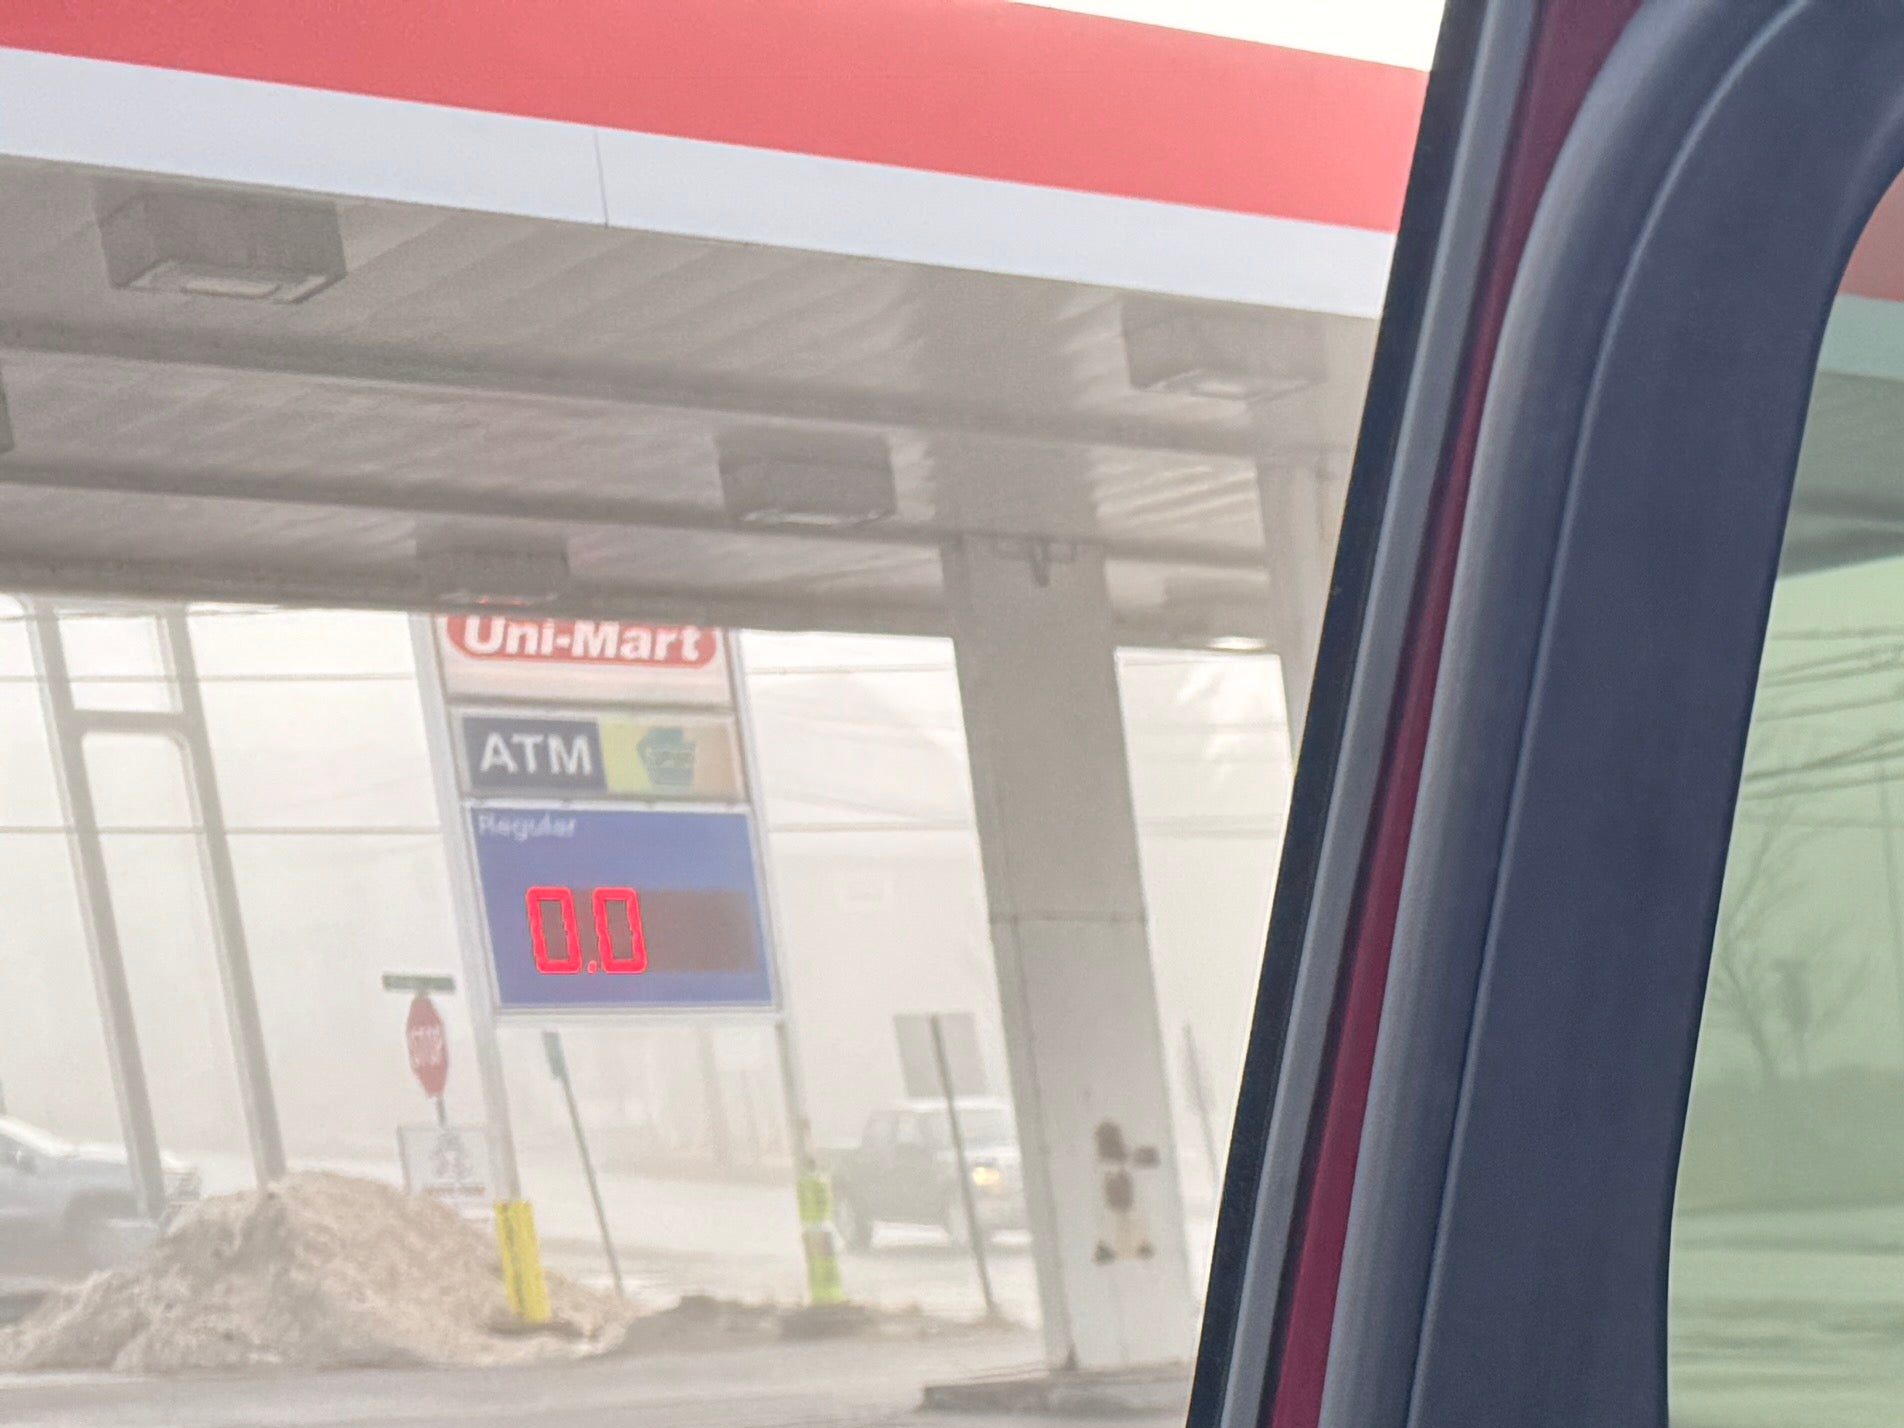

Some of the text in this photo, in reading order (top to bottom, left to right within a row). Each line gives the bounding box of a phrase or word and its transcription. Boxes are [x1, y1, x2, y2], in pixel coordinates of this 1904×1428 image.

[464, 615, 700, 661] Uni-Mart
[480, 733, 592, 775] ATM
[478, 812, 576, 841] Regular
